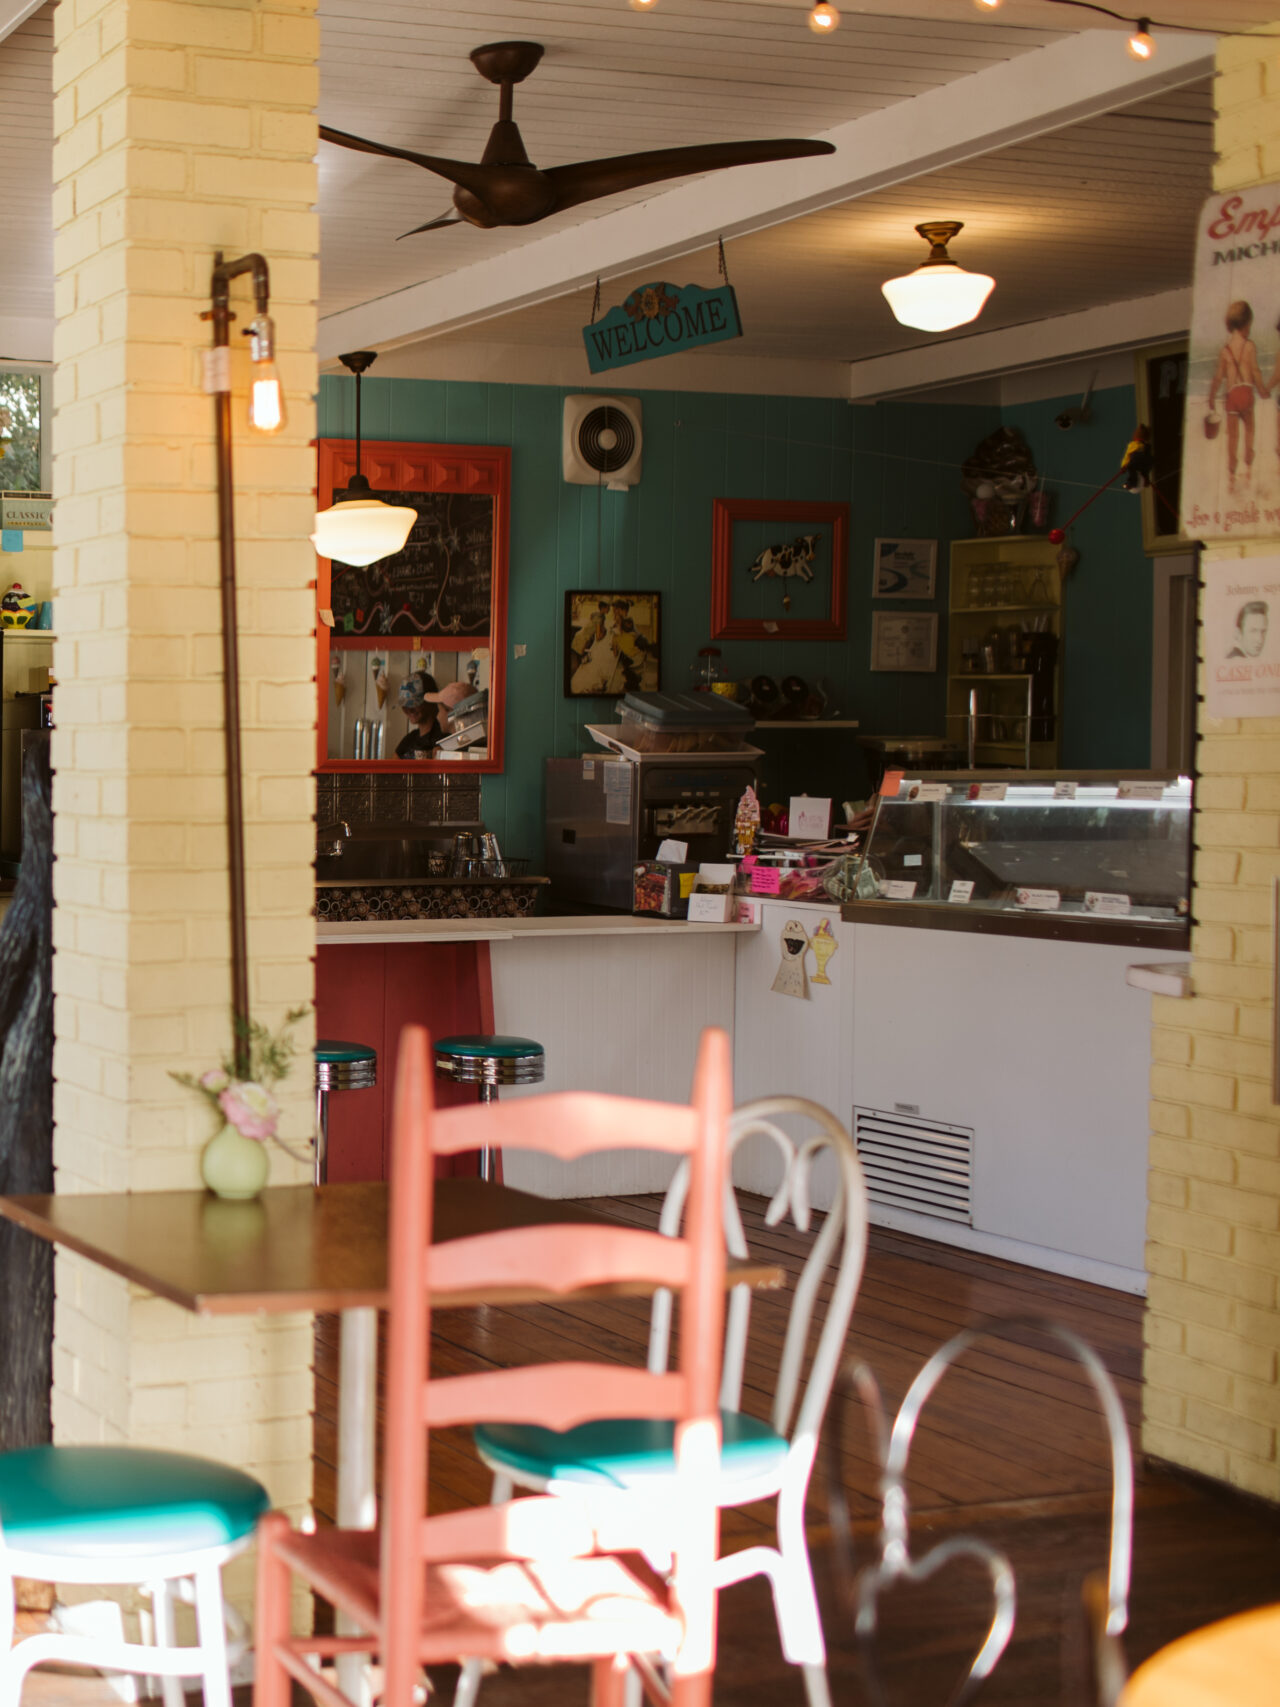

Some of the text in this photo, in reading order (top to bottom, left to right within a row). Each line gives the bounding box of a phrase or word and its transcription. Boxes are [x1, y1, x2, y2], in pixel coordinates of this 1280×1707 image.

[1211, 240, 1280, 266] MICH
[590, 298, 727, 361] WELCOME
[6, 511, 46, 519] CLASSIC
